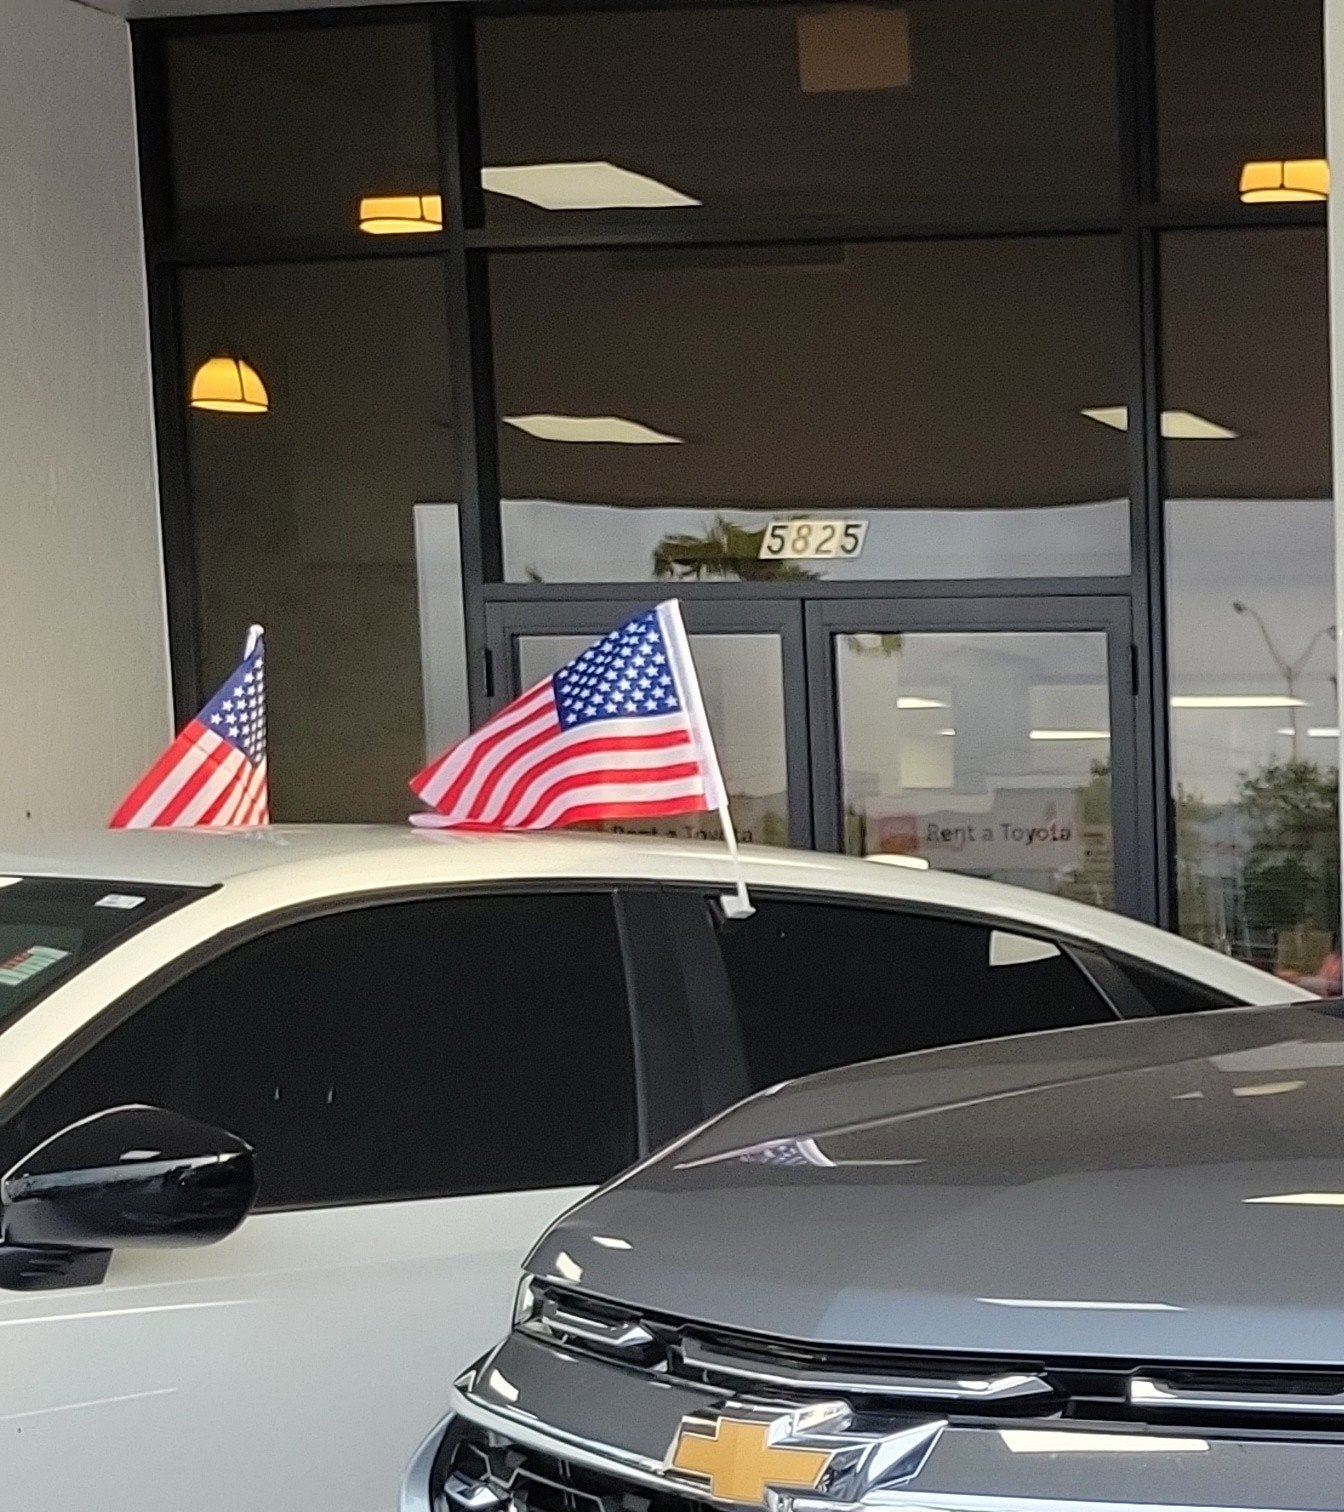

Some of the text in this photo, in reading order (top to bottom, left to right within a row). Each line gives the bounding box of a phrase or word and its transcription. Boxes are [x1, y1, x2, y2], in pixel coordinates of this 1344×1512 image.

[766, 523, 863, 555] 5825
[925, 823, 1072, 846] Rent a Toyota
